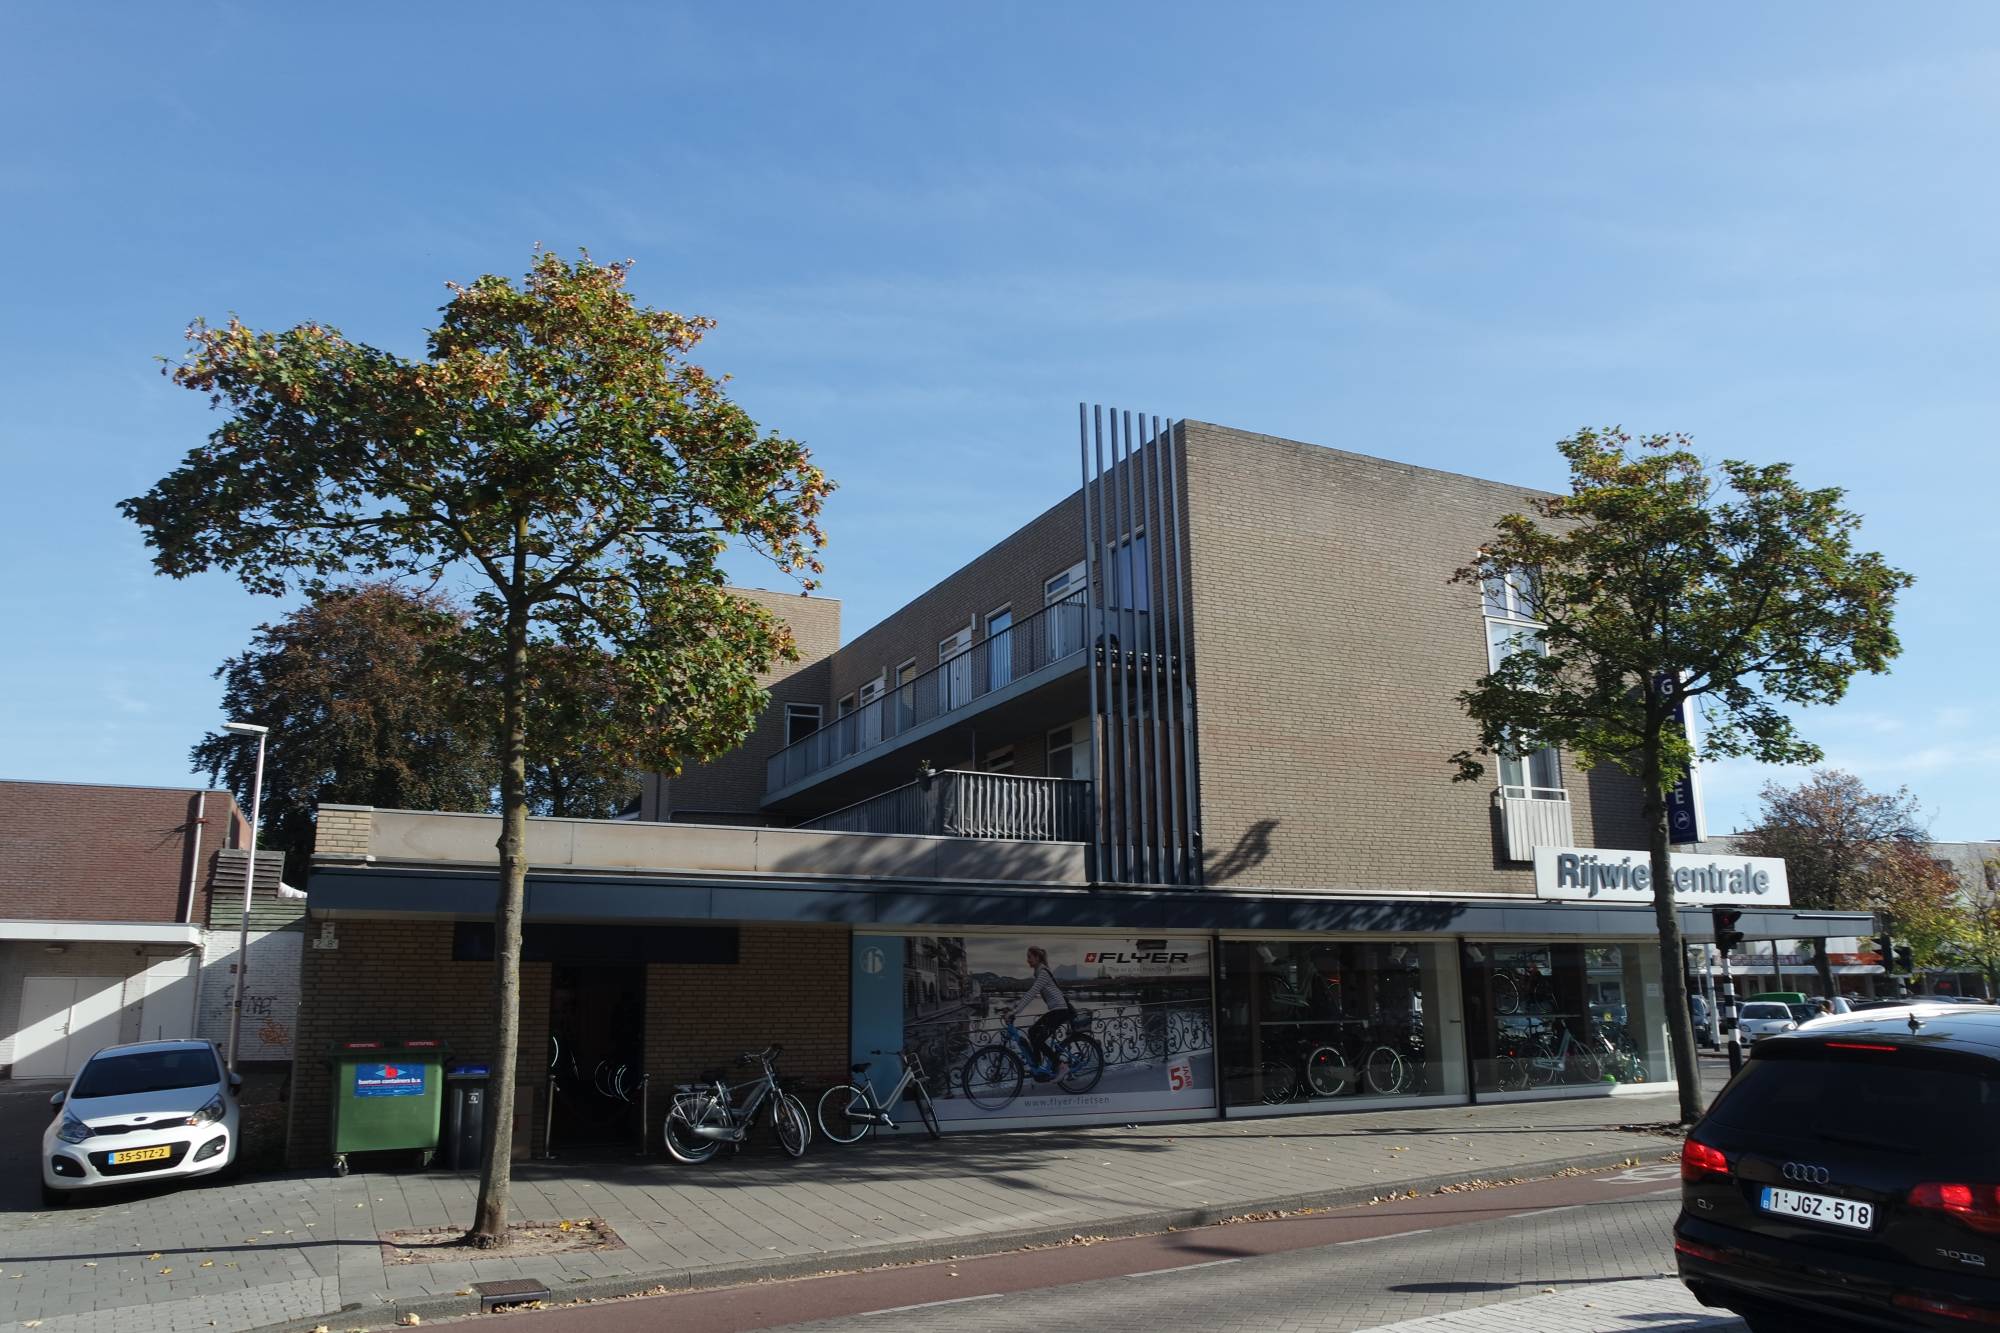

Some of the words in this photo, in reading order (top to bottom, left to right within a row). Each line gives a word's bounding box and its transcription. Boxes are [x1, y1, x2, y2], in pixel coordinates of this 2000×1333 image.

[1557, 853, 1770, 898] Rijwieentrale
[1098, 952, 1188, 964] FLYER
[1170, 1067, 1184, 1091] 5
[1182, 1065, 1193, 1088] JAAR
[119, 1148, 165, 1162] 35-STZ-2
